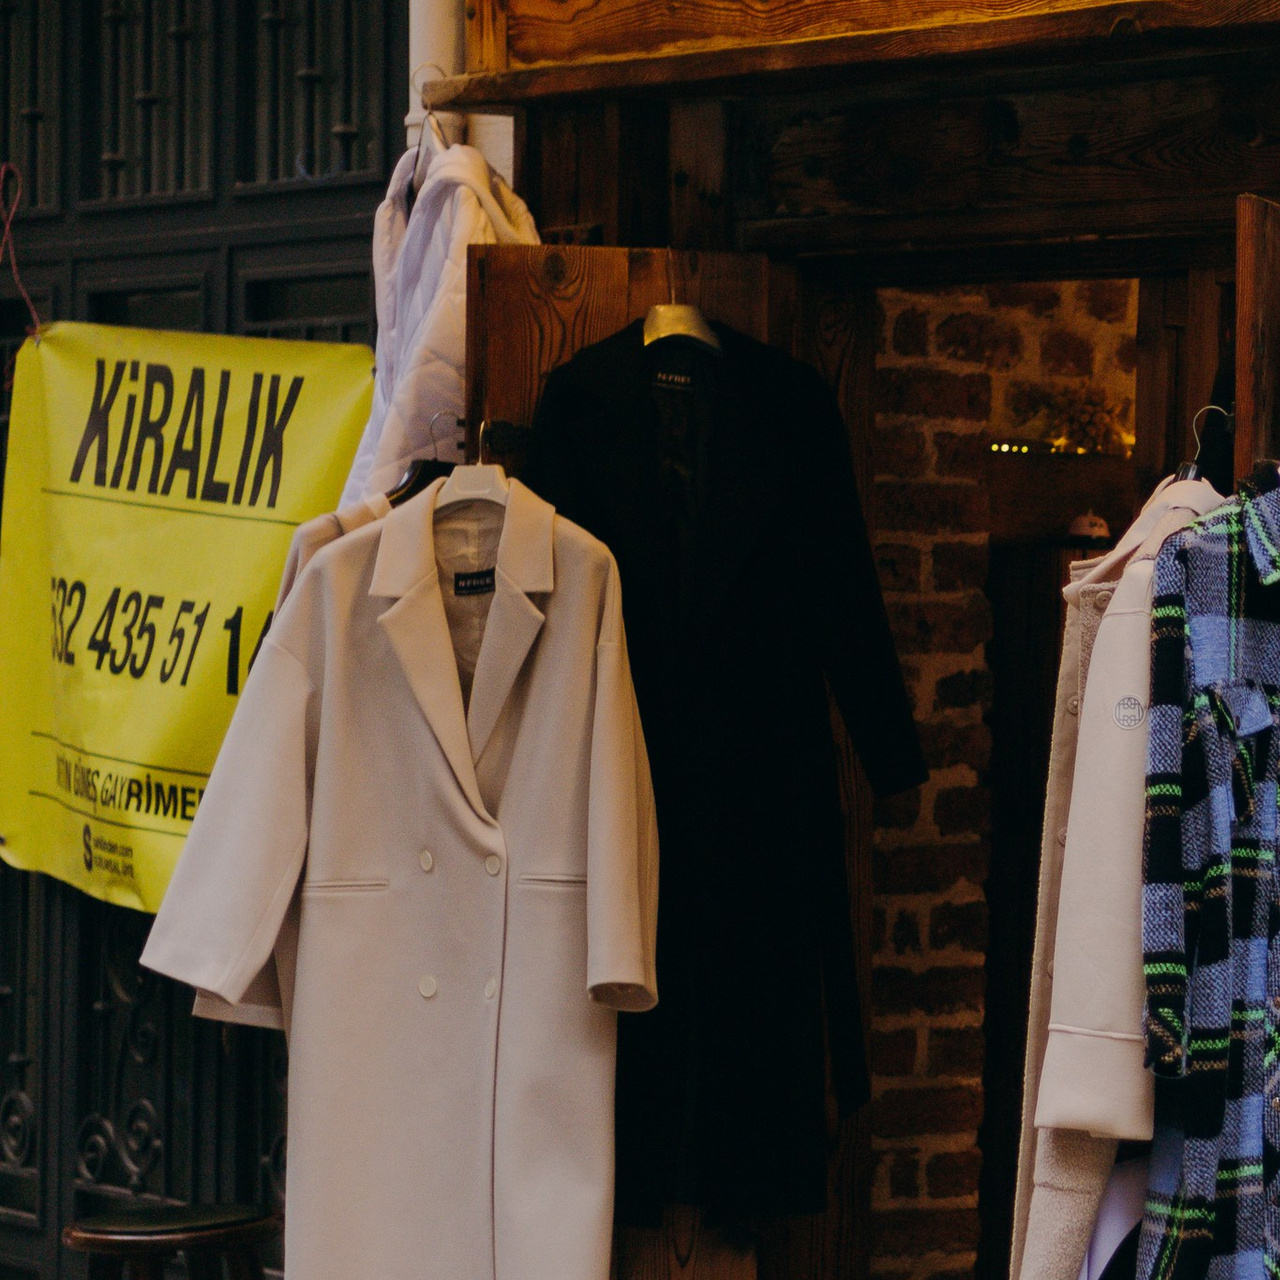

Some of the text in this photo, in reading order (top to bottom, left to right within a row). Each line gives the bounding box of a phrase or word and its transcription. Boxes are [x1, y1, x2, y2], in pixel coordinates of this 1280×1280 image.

[87, 587, 165, 680] 435
[160, 600, 211, 687] 51
[101, 773, 205, 821] GAYRİME
